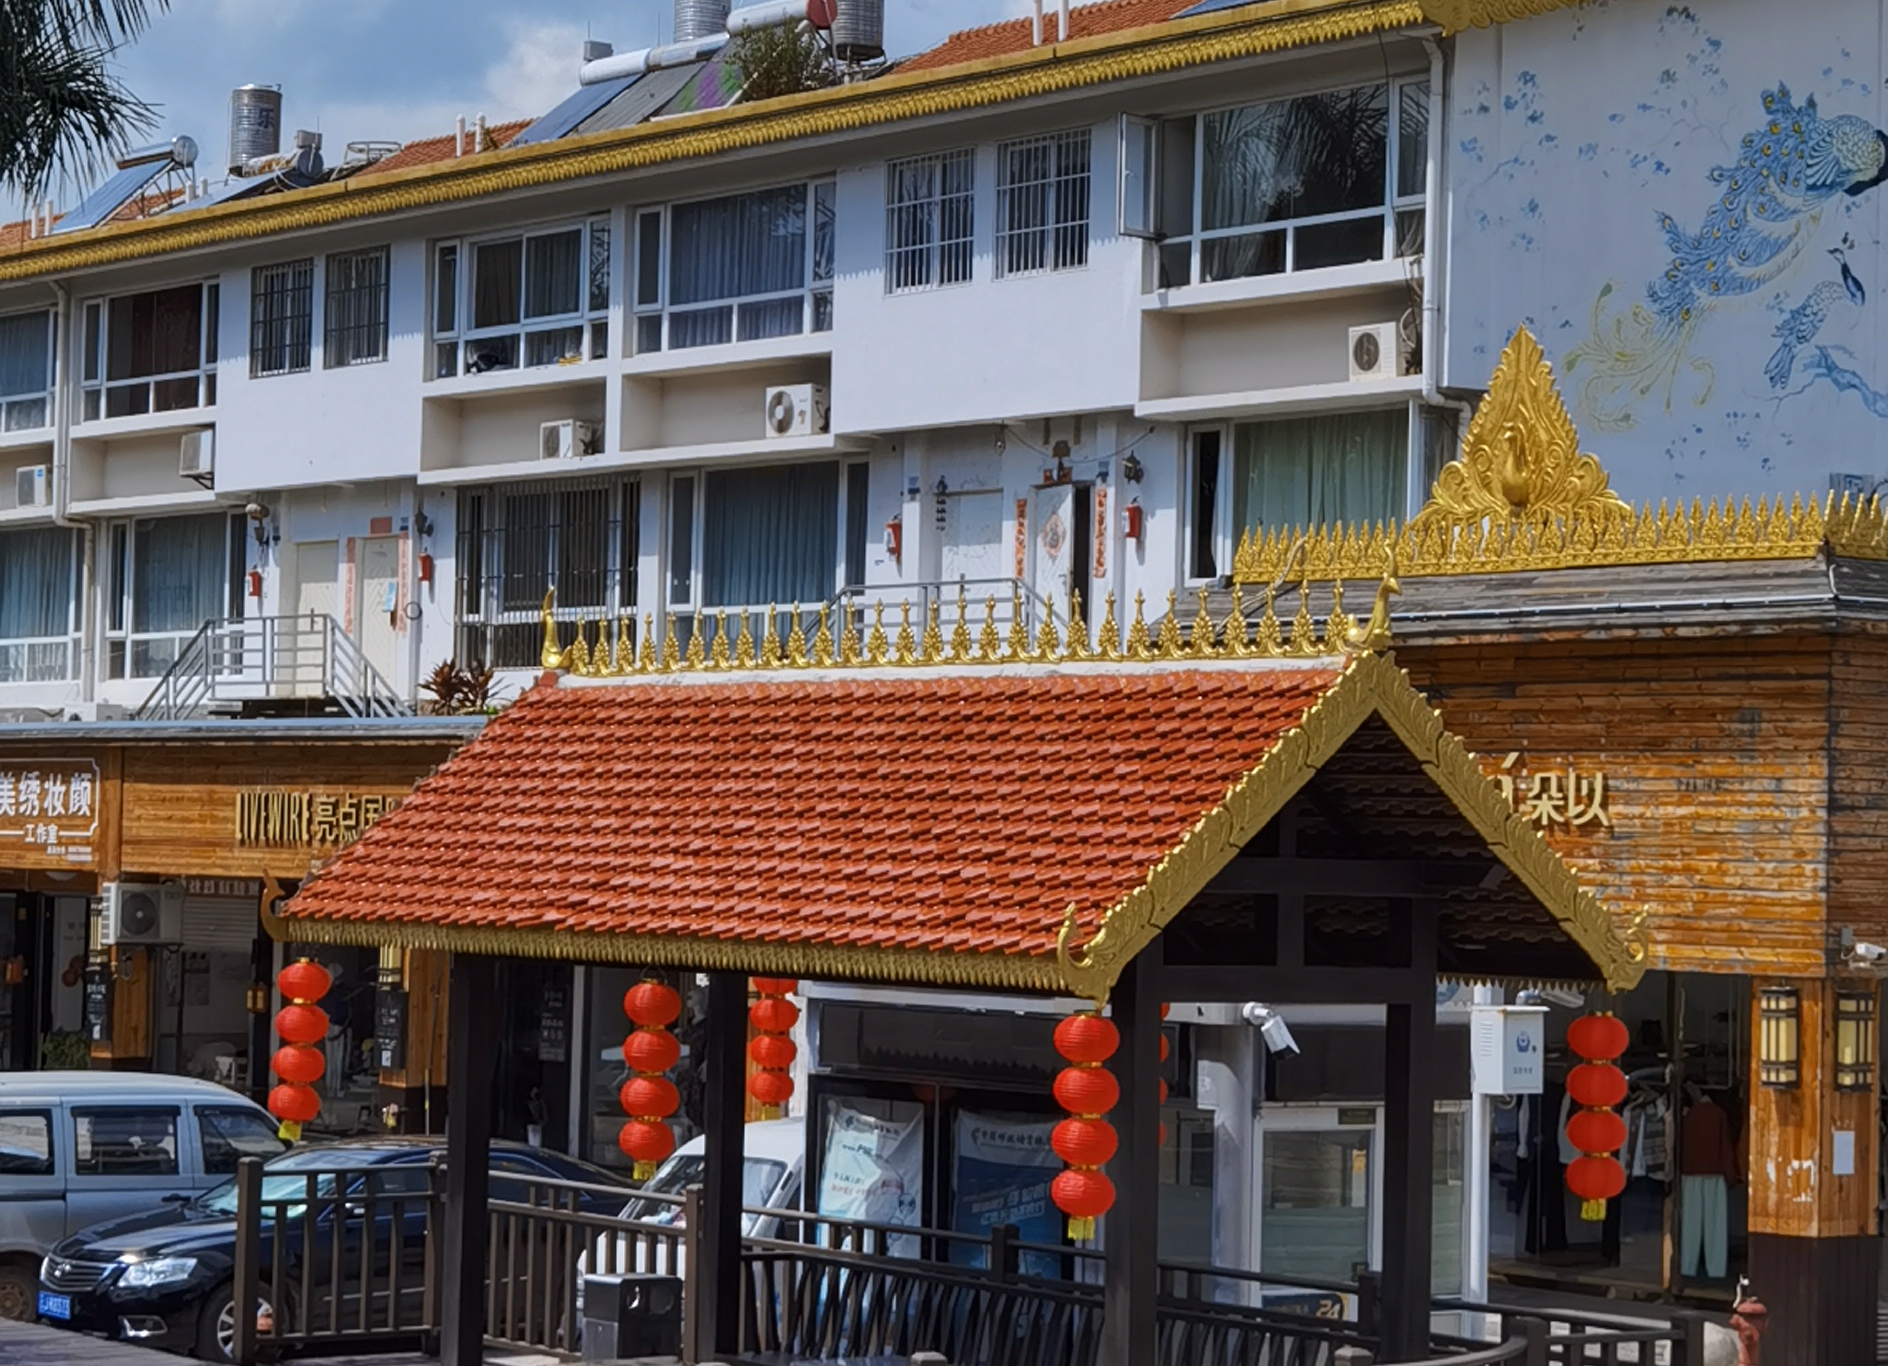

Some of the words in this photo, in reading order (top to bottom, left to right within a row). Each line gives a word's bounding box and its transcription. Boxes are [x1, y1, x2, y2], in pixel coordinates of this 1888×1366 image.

[0, 771, 92, 817] 美绣妆颜
[235, 792, 310, 841] LIVEWIRE
[315, 792, 398, 841] 亮点国
[1526, 768, 1609, 826] 朵以
[24, 823, 58, 844] 工作室
